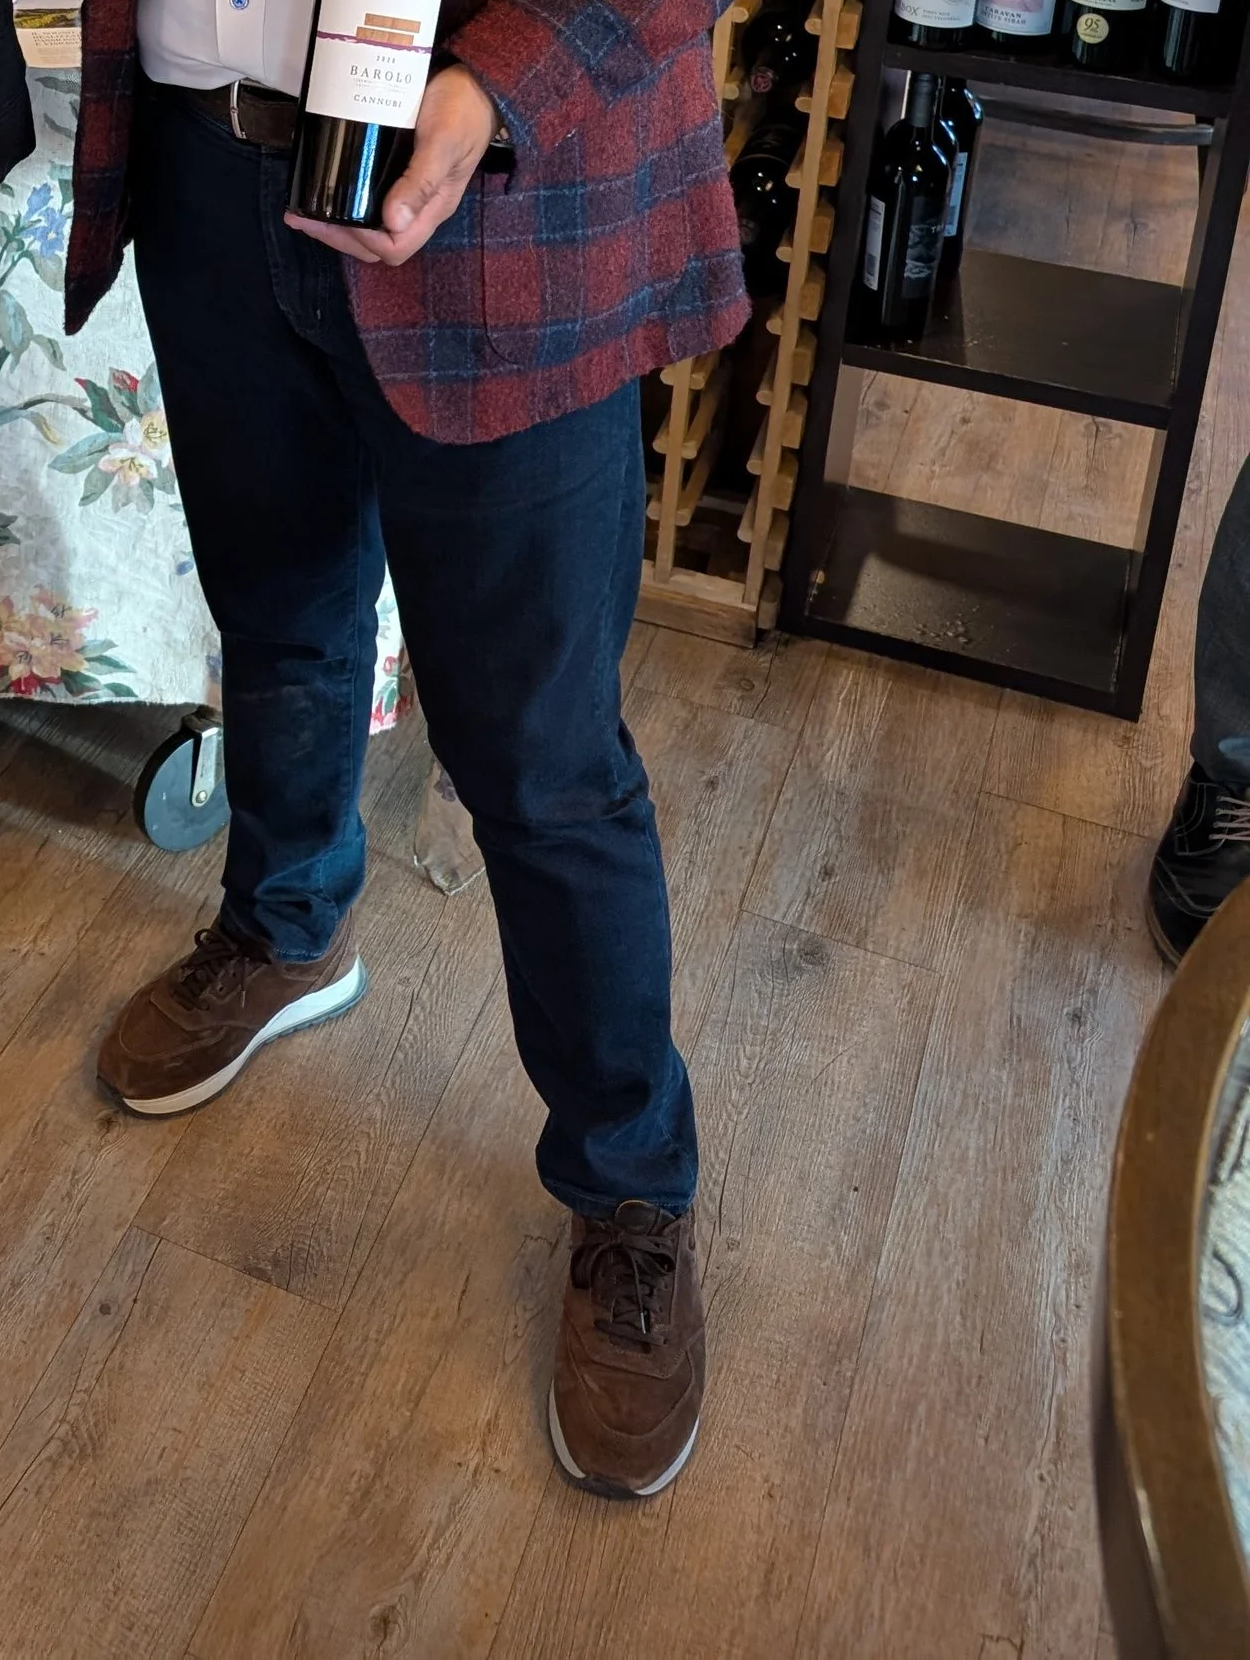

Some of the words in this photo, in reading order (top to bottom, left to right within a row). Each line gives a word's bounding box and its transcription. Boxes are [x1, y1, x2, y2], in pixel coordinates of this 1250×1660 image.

[1084, 17, 1101, 31] 95
[350, 65, 412, 85] BAROLO
[353, 94, 402, 108] CANNUBI
